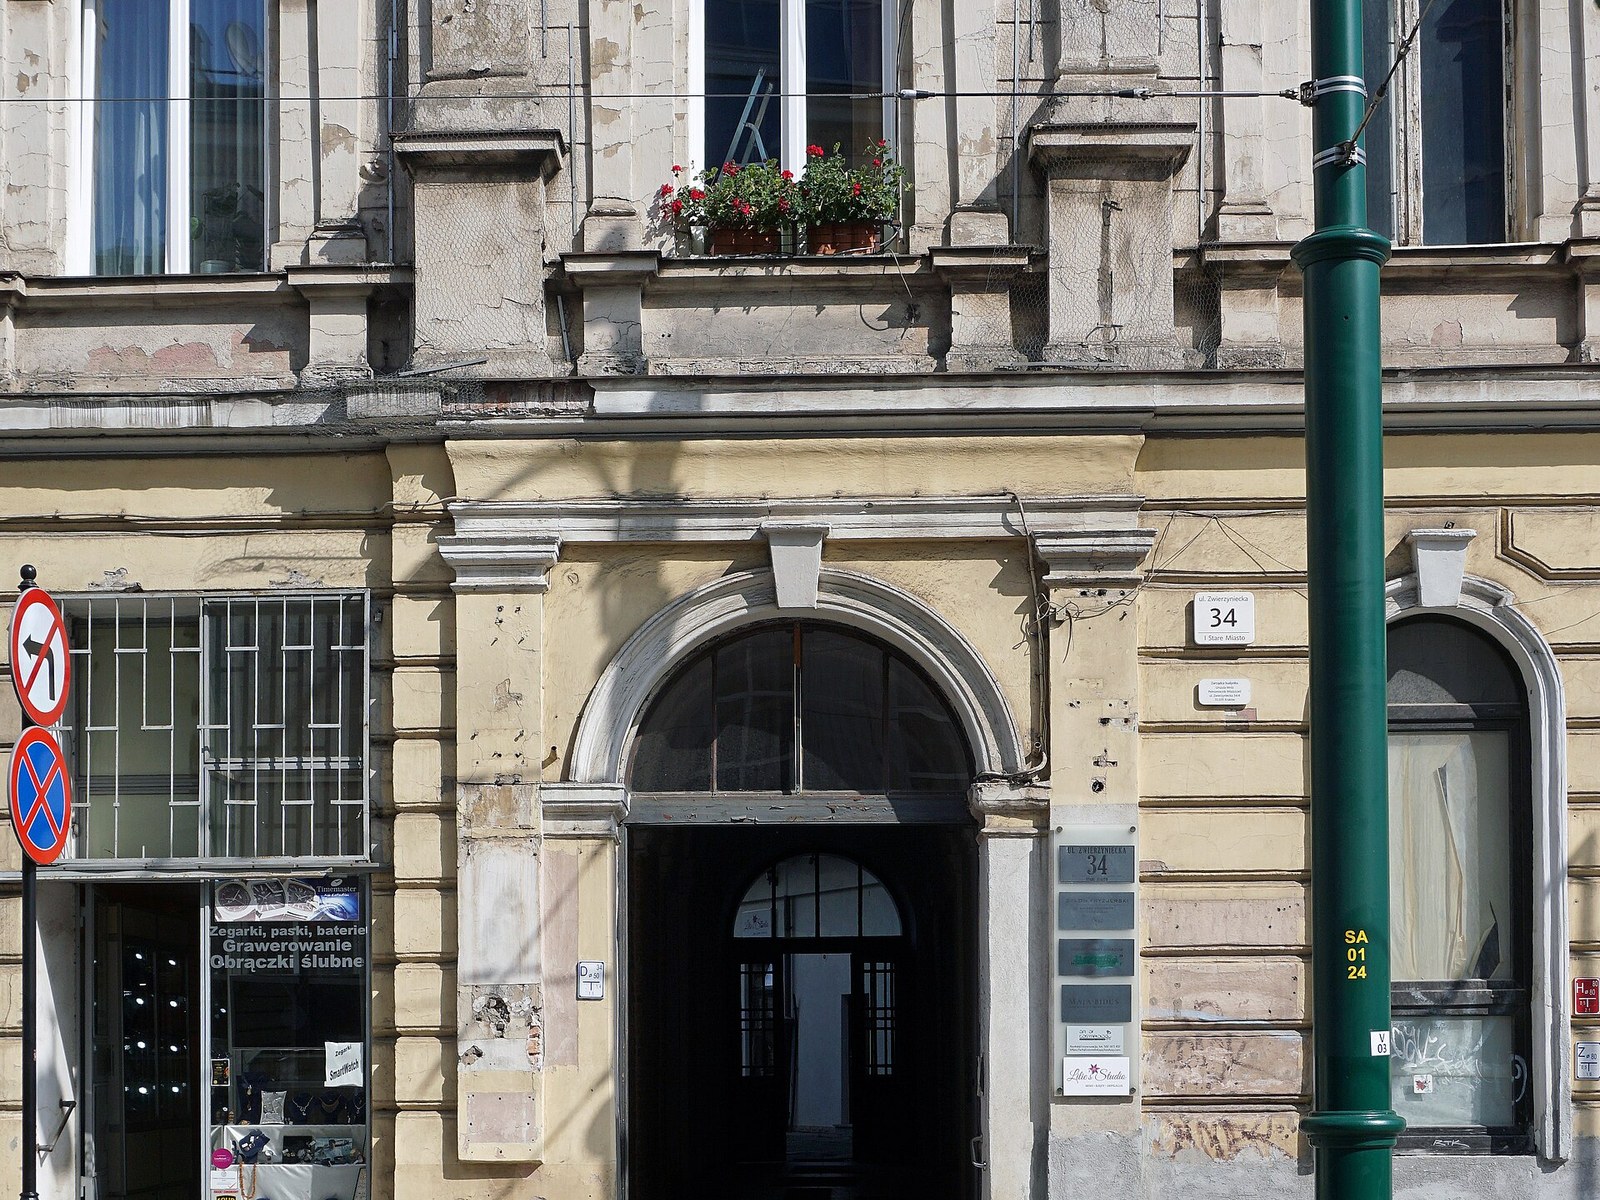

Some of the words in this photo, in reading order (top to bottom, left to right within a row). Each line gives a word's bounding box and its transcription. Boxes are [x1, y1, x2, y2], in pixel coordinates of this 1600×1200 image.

[1207, 595, 1249, 604] Zwierzyniecka
[1210, 607, 1238, 628] 34
[1079, 846, 1127, 855] ZWIERZYNIECKA
[1086, 854, 1108, 876] 34
[209, 925, 267, 938] Zegarki,
[271, 925, 313, 938] paski,
[317, 925, 365, 937] baterie
[1344, 930, 1369, 944] SA
[222, 939, 352, 953] Grawerowanie
[1347, 947, 1366, 962] 01
[210, 954, 294, 972] Obrączki
[301, 954, 365, 969] ślubne
[580, 965, 588, 977] D
[1347, 965, 1367, 980] 24
[1576, 982, 1584, 994] H
[1378, 1033, 1385, 1043] V
[1377, 1043, 1388, 1054] 03
[1578, 1047, 1585, 1058] Z
[330, 1058, 360, 1080] SmartWatch
[1094, 1068, 1127, 1082] Studio
